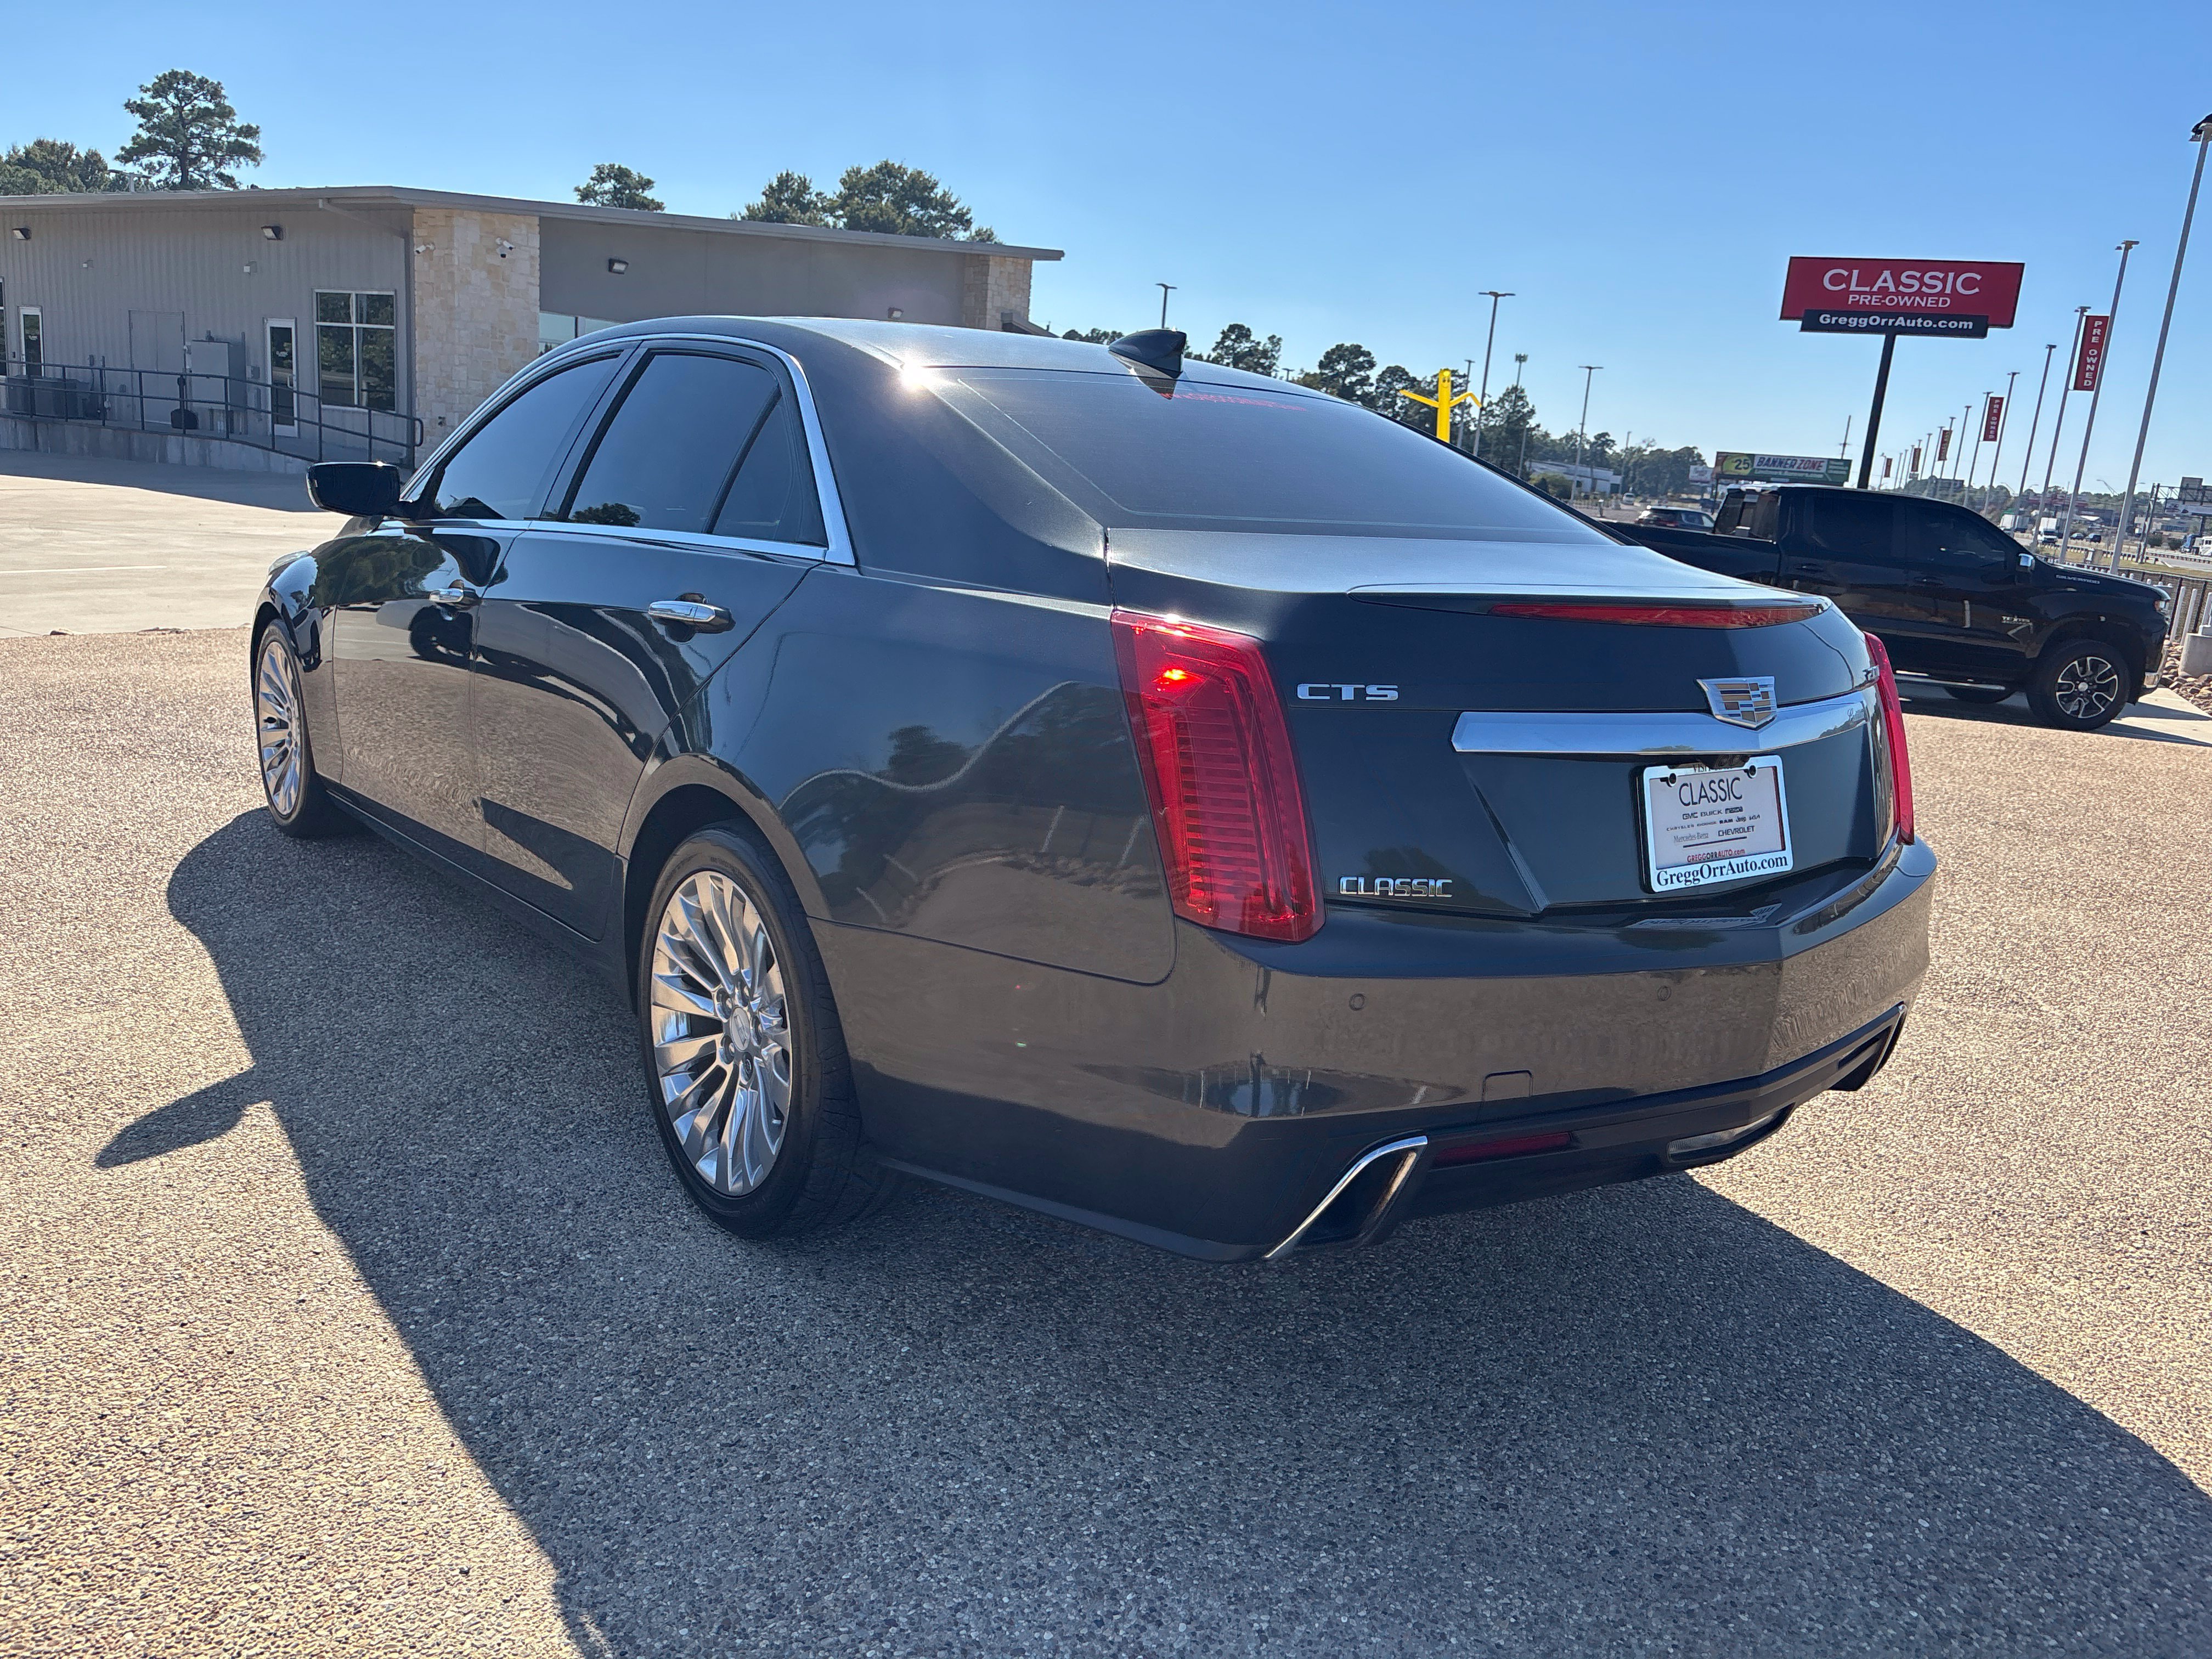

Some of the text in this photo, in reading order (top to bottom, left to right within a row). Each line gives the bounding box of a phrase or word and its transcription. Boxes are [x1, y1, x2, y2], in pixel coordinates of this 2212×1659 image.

[1822, 269, 1982, 295] CLASSIC
[1848, 295, 1951, 308] PRE-OWNED
[1819, 314, 1973, 330] GreggOrrAuto.com
[2084, 321, 2103, 387] PRE OWNED
[1297, 683, 1398, 701] CTS
[1679, 777, 1742, 806] CLASSIC
[1682, 812, 1699, 820] GMC
[1673, 825, 1755, 843] Mercedes-Benz CHEVROLET
[1656, 855, 1788, 886] GreggOrrAuto.com
[1340, 876, 1453, 898] CLASSIC
